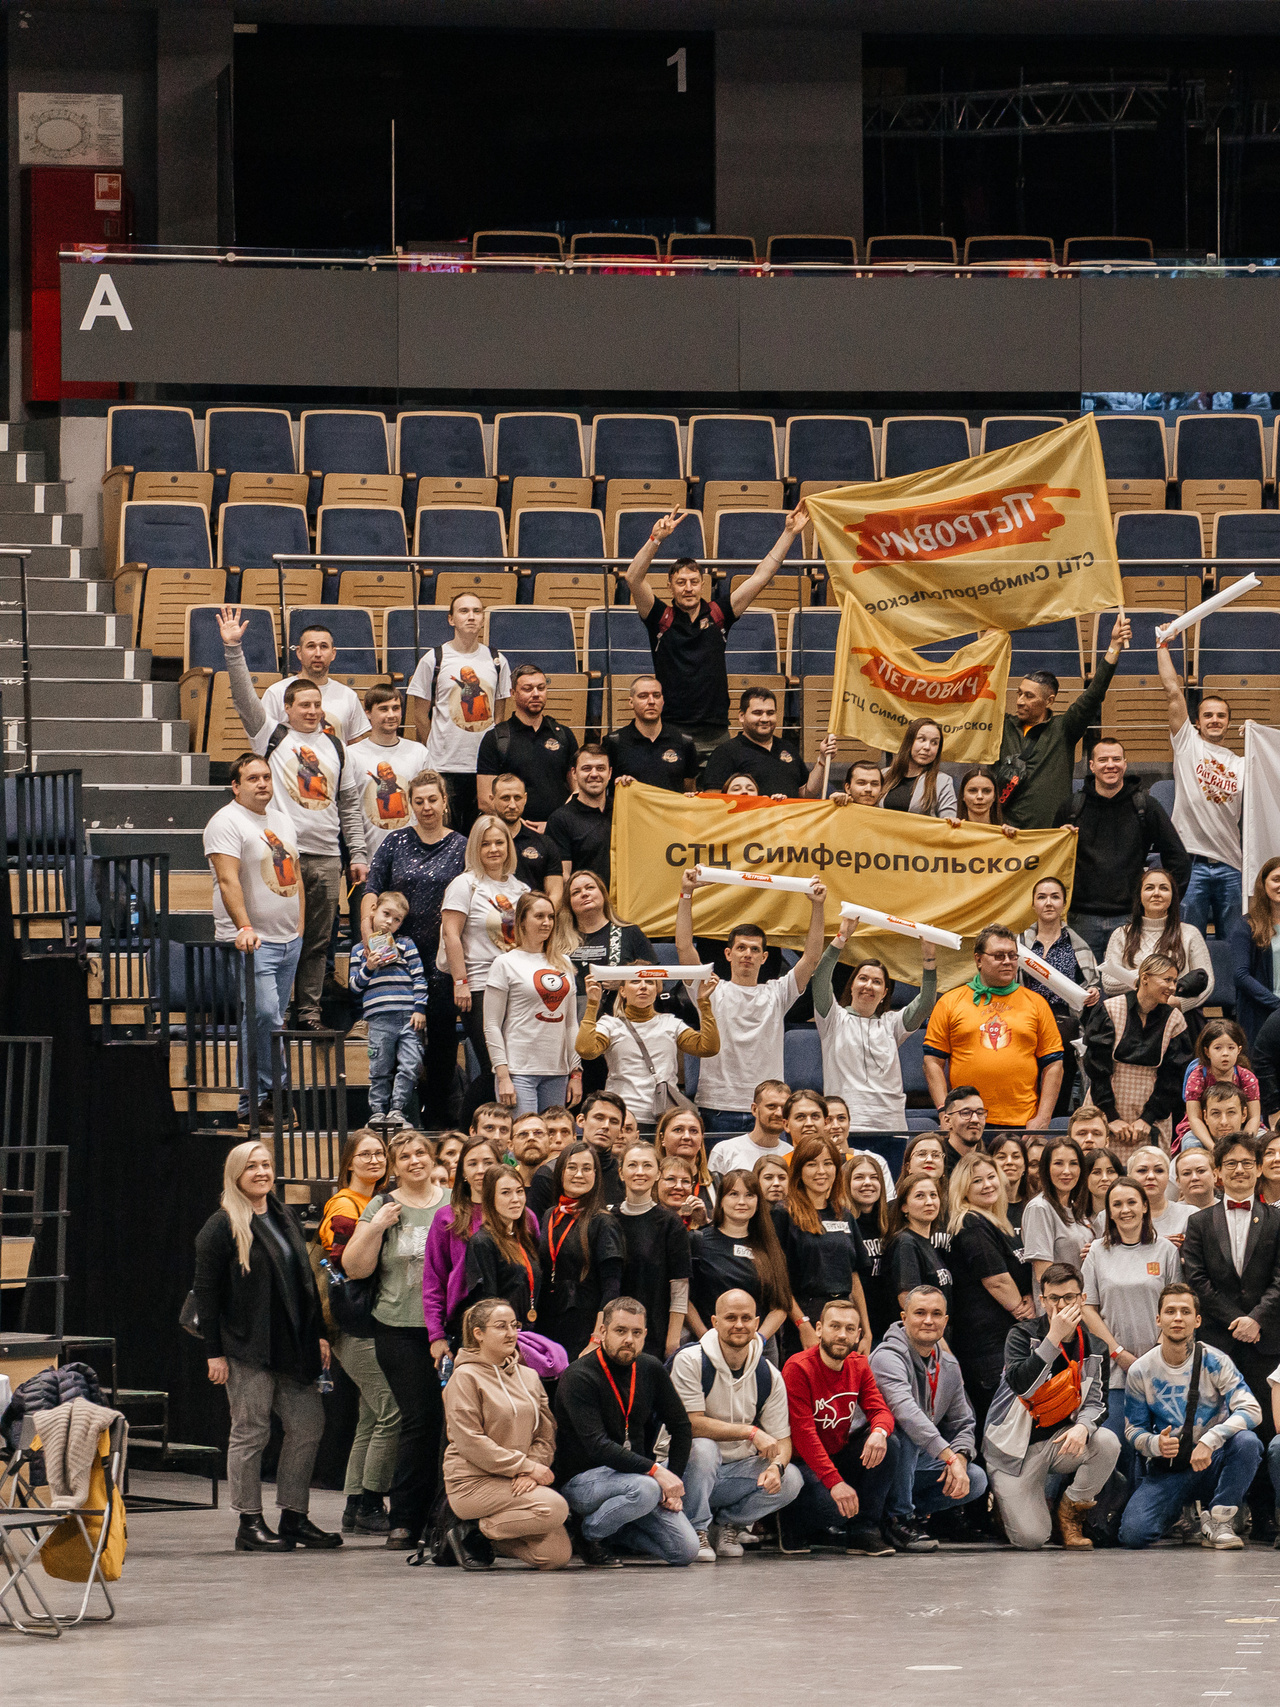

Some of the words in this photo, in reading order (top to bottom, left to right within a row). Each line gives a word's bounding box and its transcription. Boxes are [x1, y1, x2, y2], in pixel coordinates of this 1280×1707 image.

[666, 47, 688, 93] 1
[79, 273, 133, 331] A
[842, 690, 865, 712] СТЦ
[665, 842, 731, 869] СТЦ
[742, 842, 1041, 874] Симферопольское
